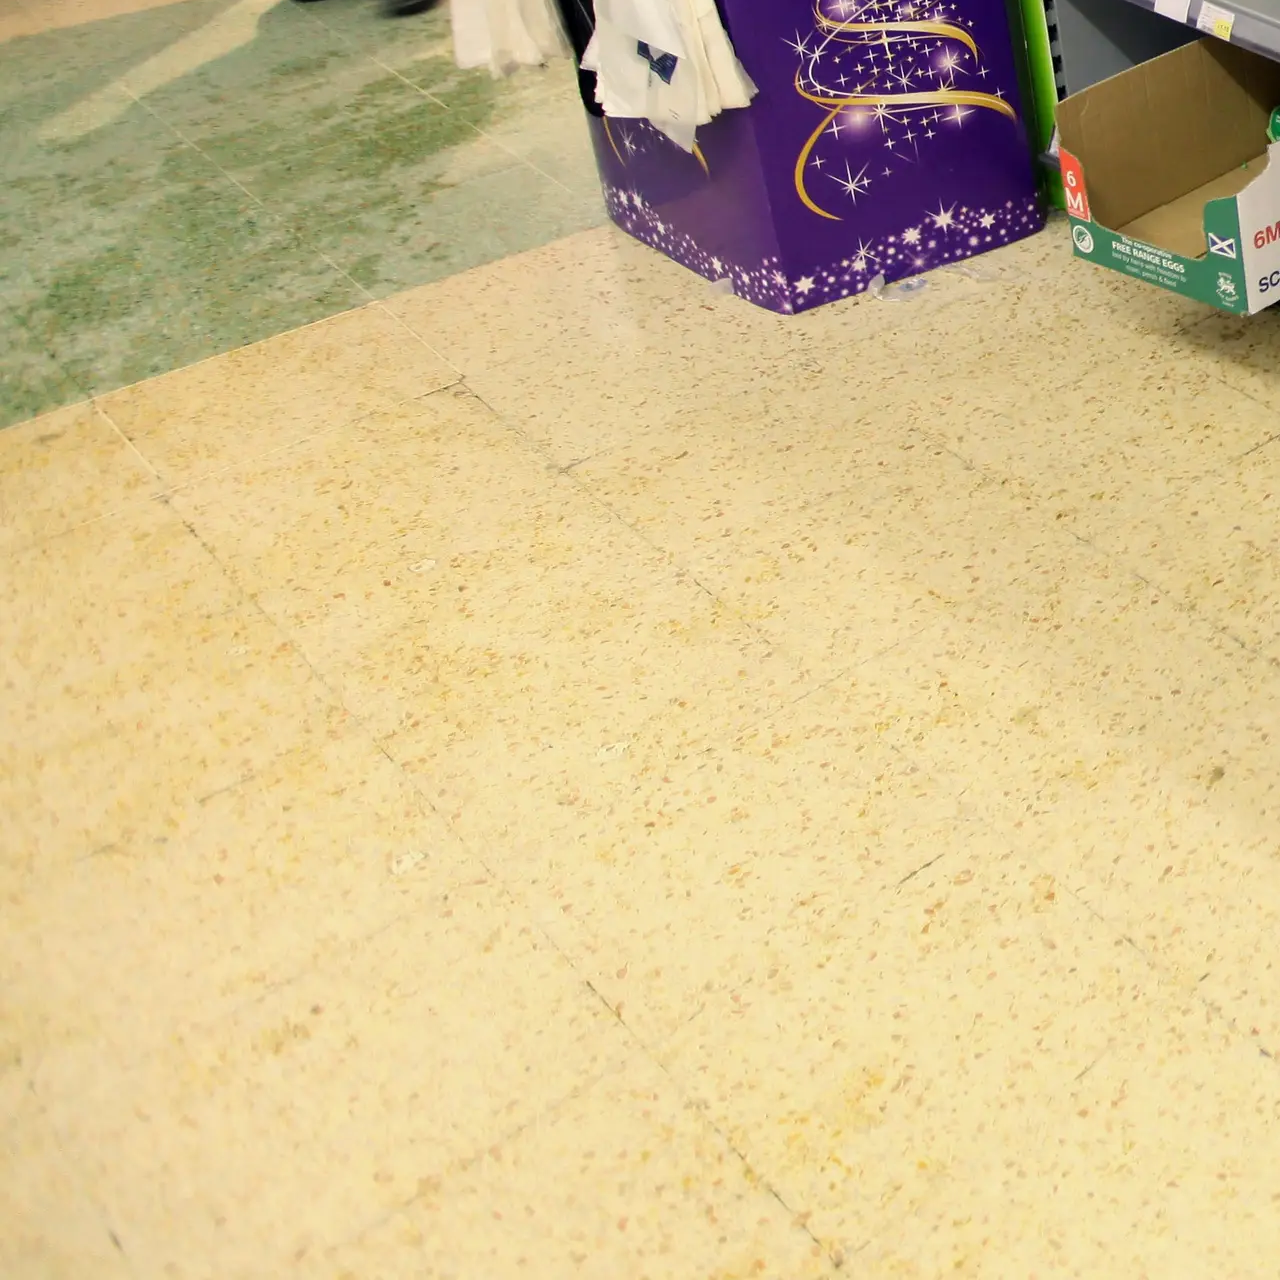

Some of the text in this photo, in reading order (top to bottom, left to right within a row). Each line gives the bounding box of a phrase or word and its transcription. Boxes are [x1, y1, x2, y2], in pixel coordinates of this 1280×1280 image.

[1066, 170, 1077, 188] 6
[1064, 187, 1086, 213] M
[1112, 240, 1185, 274] FREE RANGE EGGS
